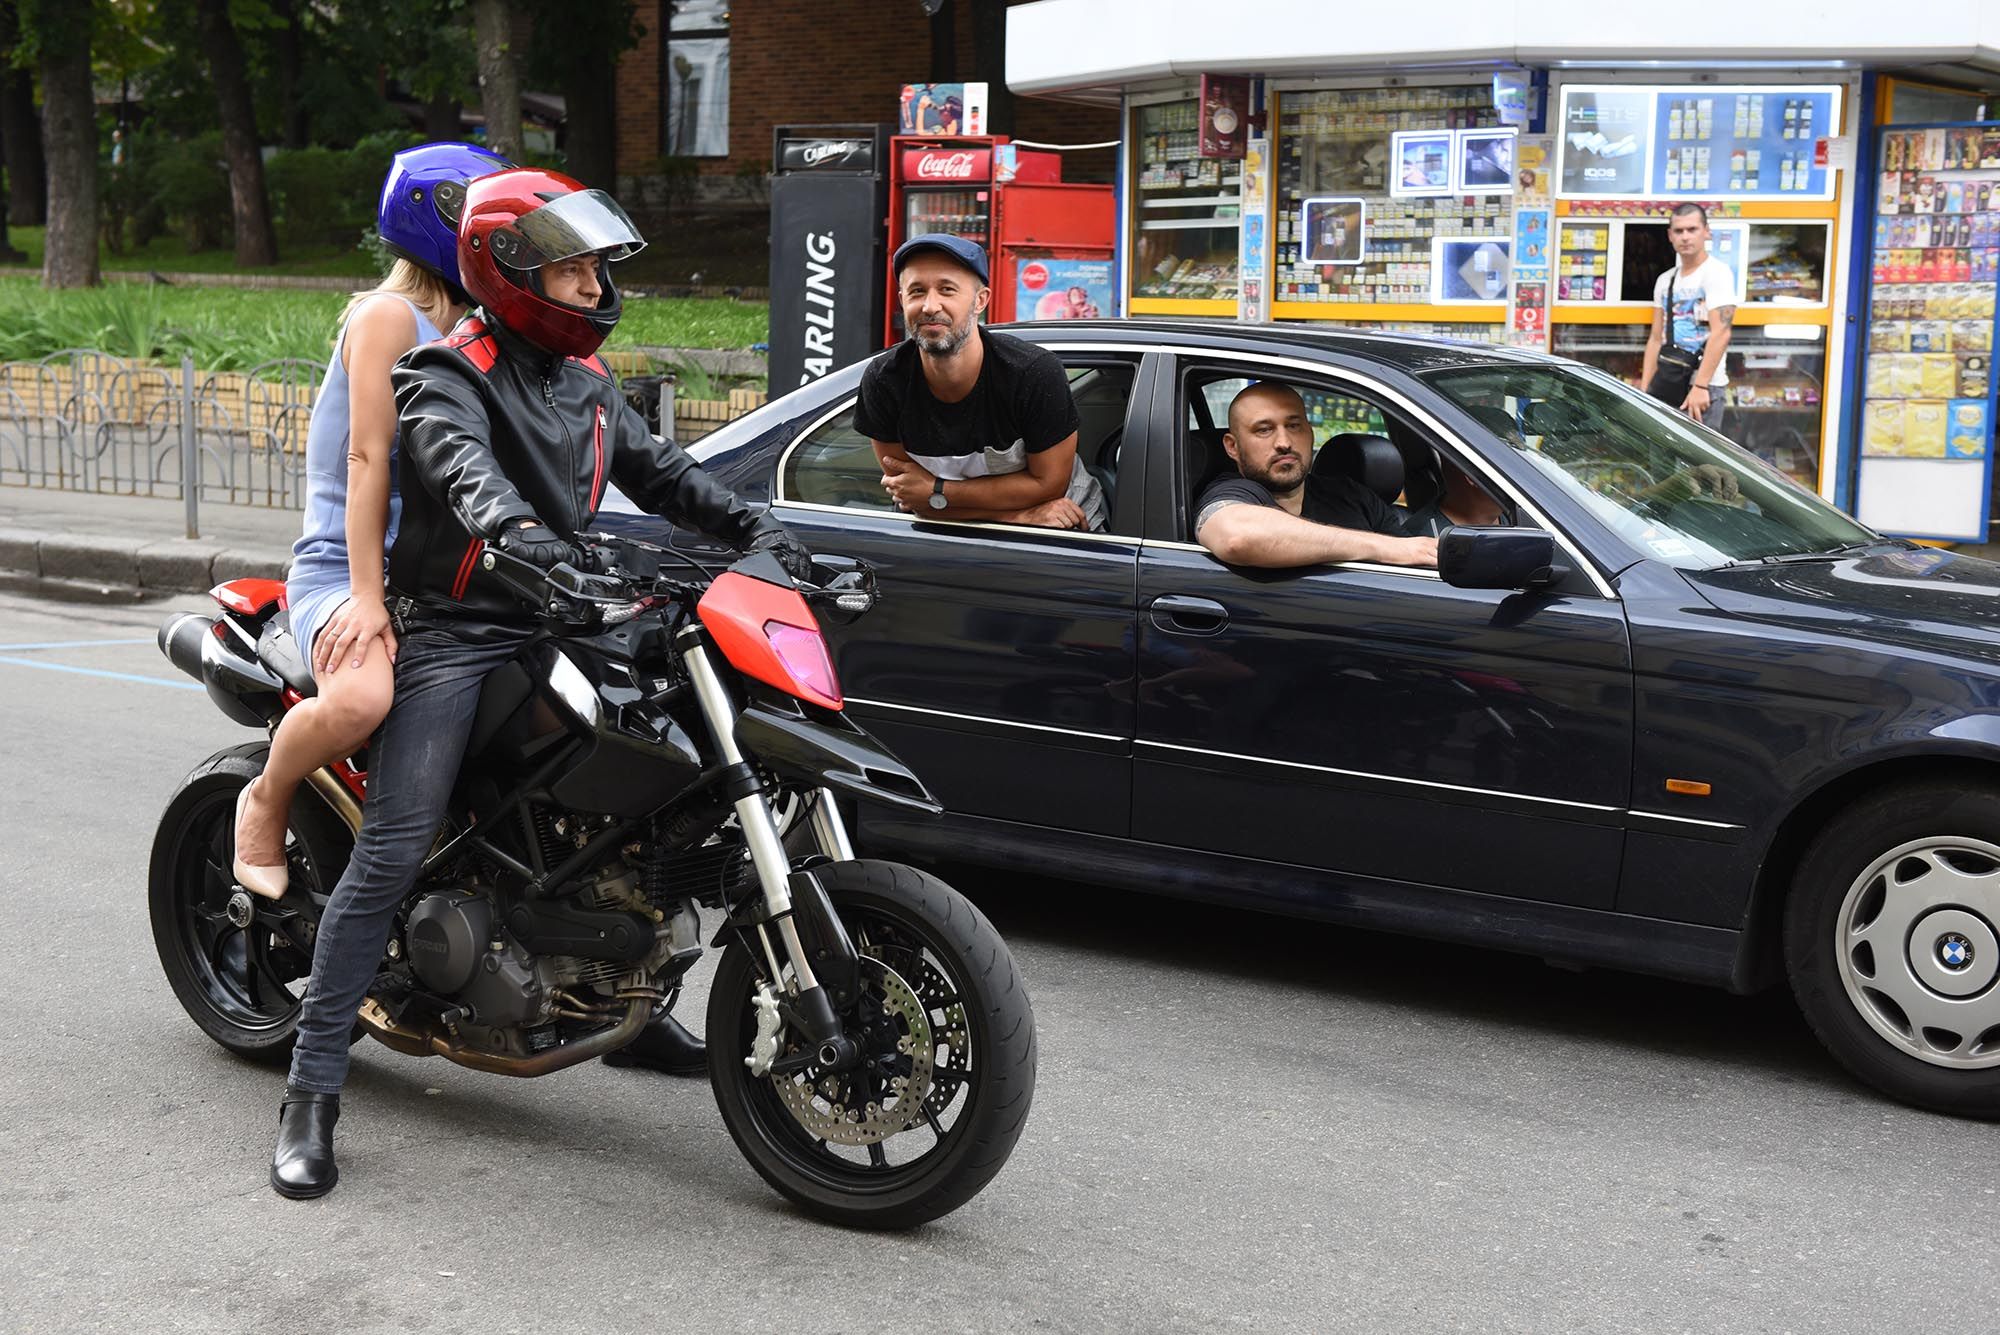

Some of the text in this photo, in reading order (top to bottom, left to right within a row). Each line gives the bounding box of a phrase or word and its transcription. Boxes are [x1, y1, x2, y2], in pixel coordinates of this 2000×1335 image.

[803, 141, 848, 163] CARLING
[1584, 168, 1616, 178] IQOS
[1948, 936, 1972, 960] BMW
